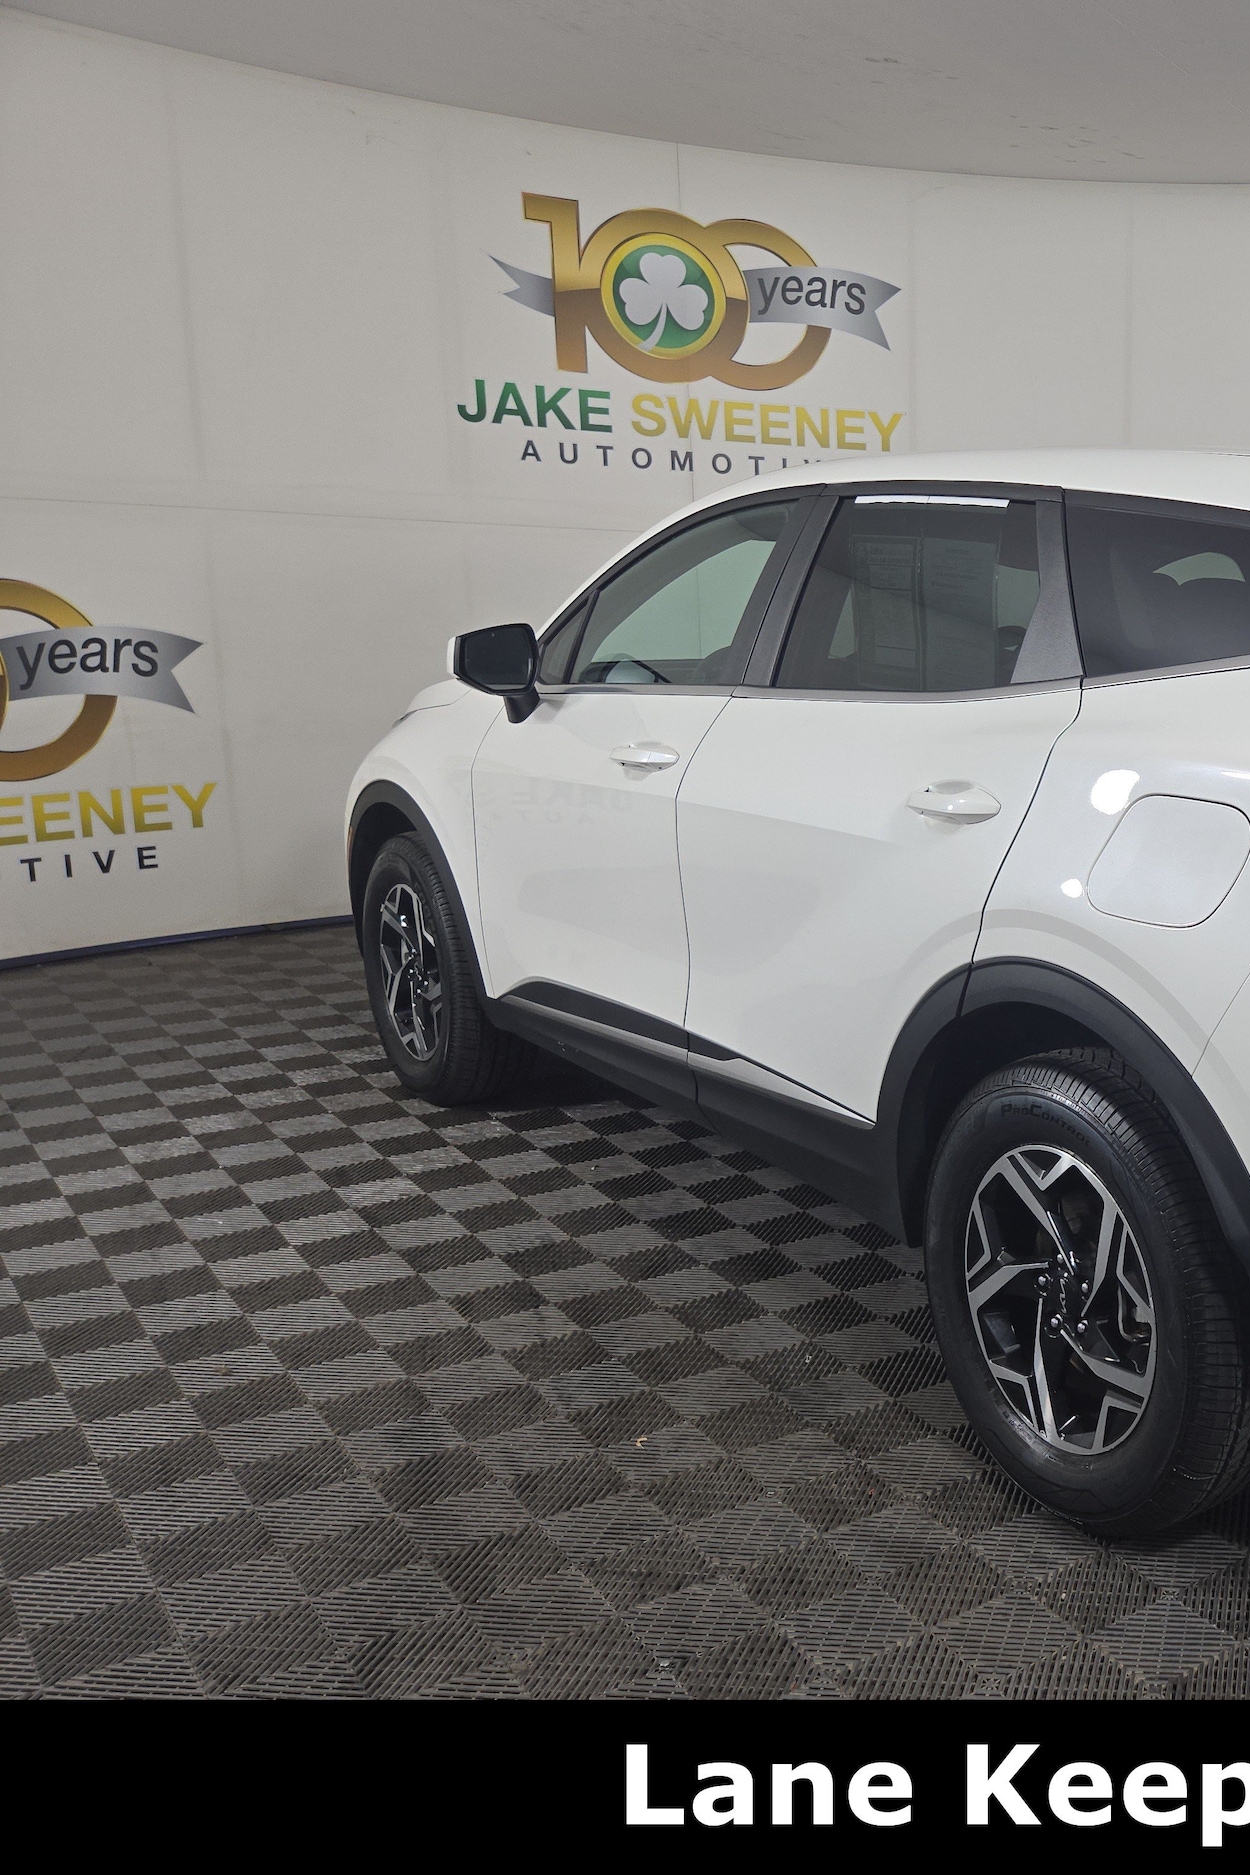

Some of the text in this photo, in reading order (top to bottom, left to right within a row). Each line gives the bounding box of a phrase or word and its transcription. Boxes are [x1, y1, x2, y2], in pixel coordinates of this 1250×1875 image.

[521, 192, 832, 391] 100
[756, 274, 867, 315] years
[457, 379, 904, 452] JAKE SWEENEY
[521, 440, 821, 476] AUTOMOT
[16, 637, 159, 691] years
